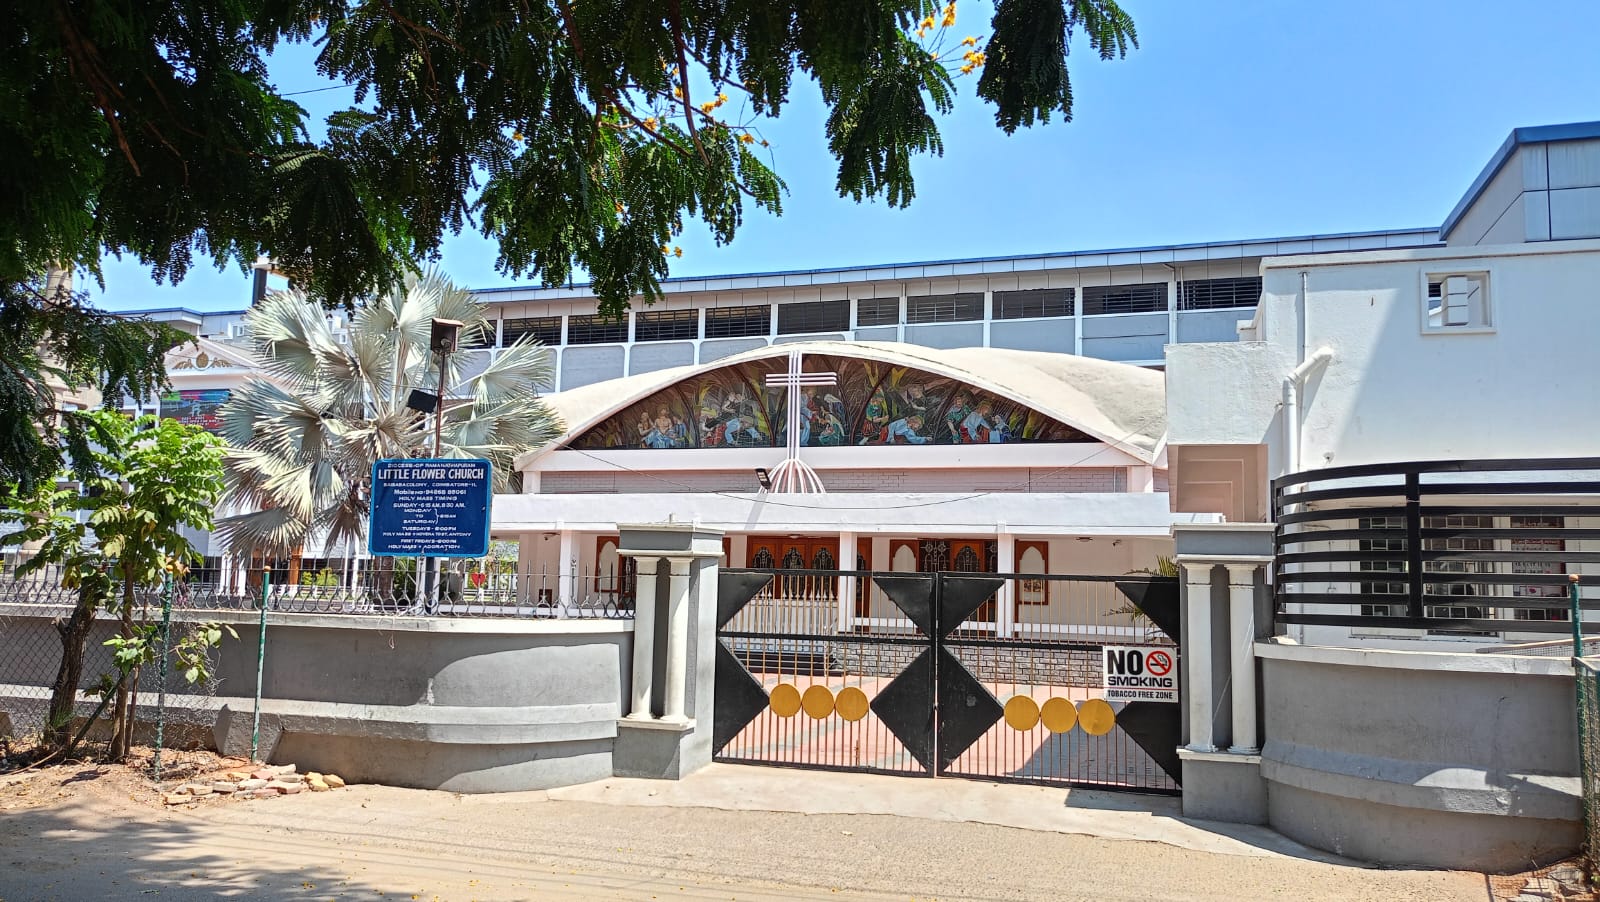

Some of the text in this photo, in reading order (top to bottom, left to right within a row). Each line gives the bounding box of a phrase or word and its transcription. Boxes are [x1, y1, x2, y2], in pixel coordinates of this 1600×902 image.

[378, 469, 484, 480] LITTLE FLOWER CHURCH
[1107, 650, 1143, 675] NO
[1108, 676, 1173, 688] SMOKING
[1108, 690, 1137, 698] TOBACCO
[1155, 691, 1173, 699] ZONE
